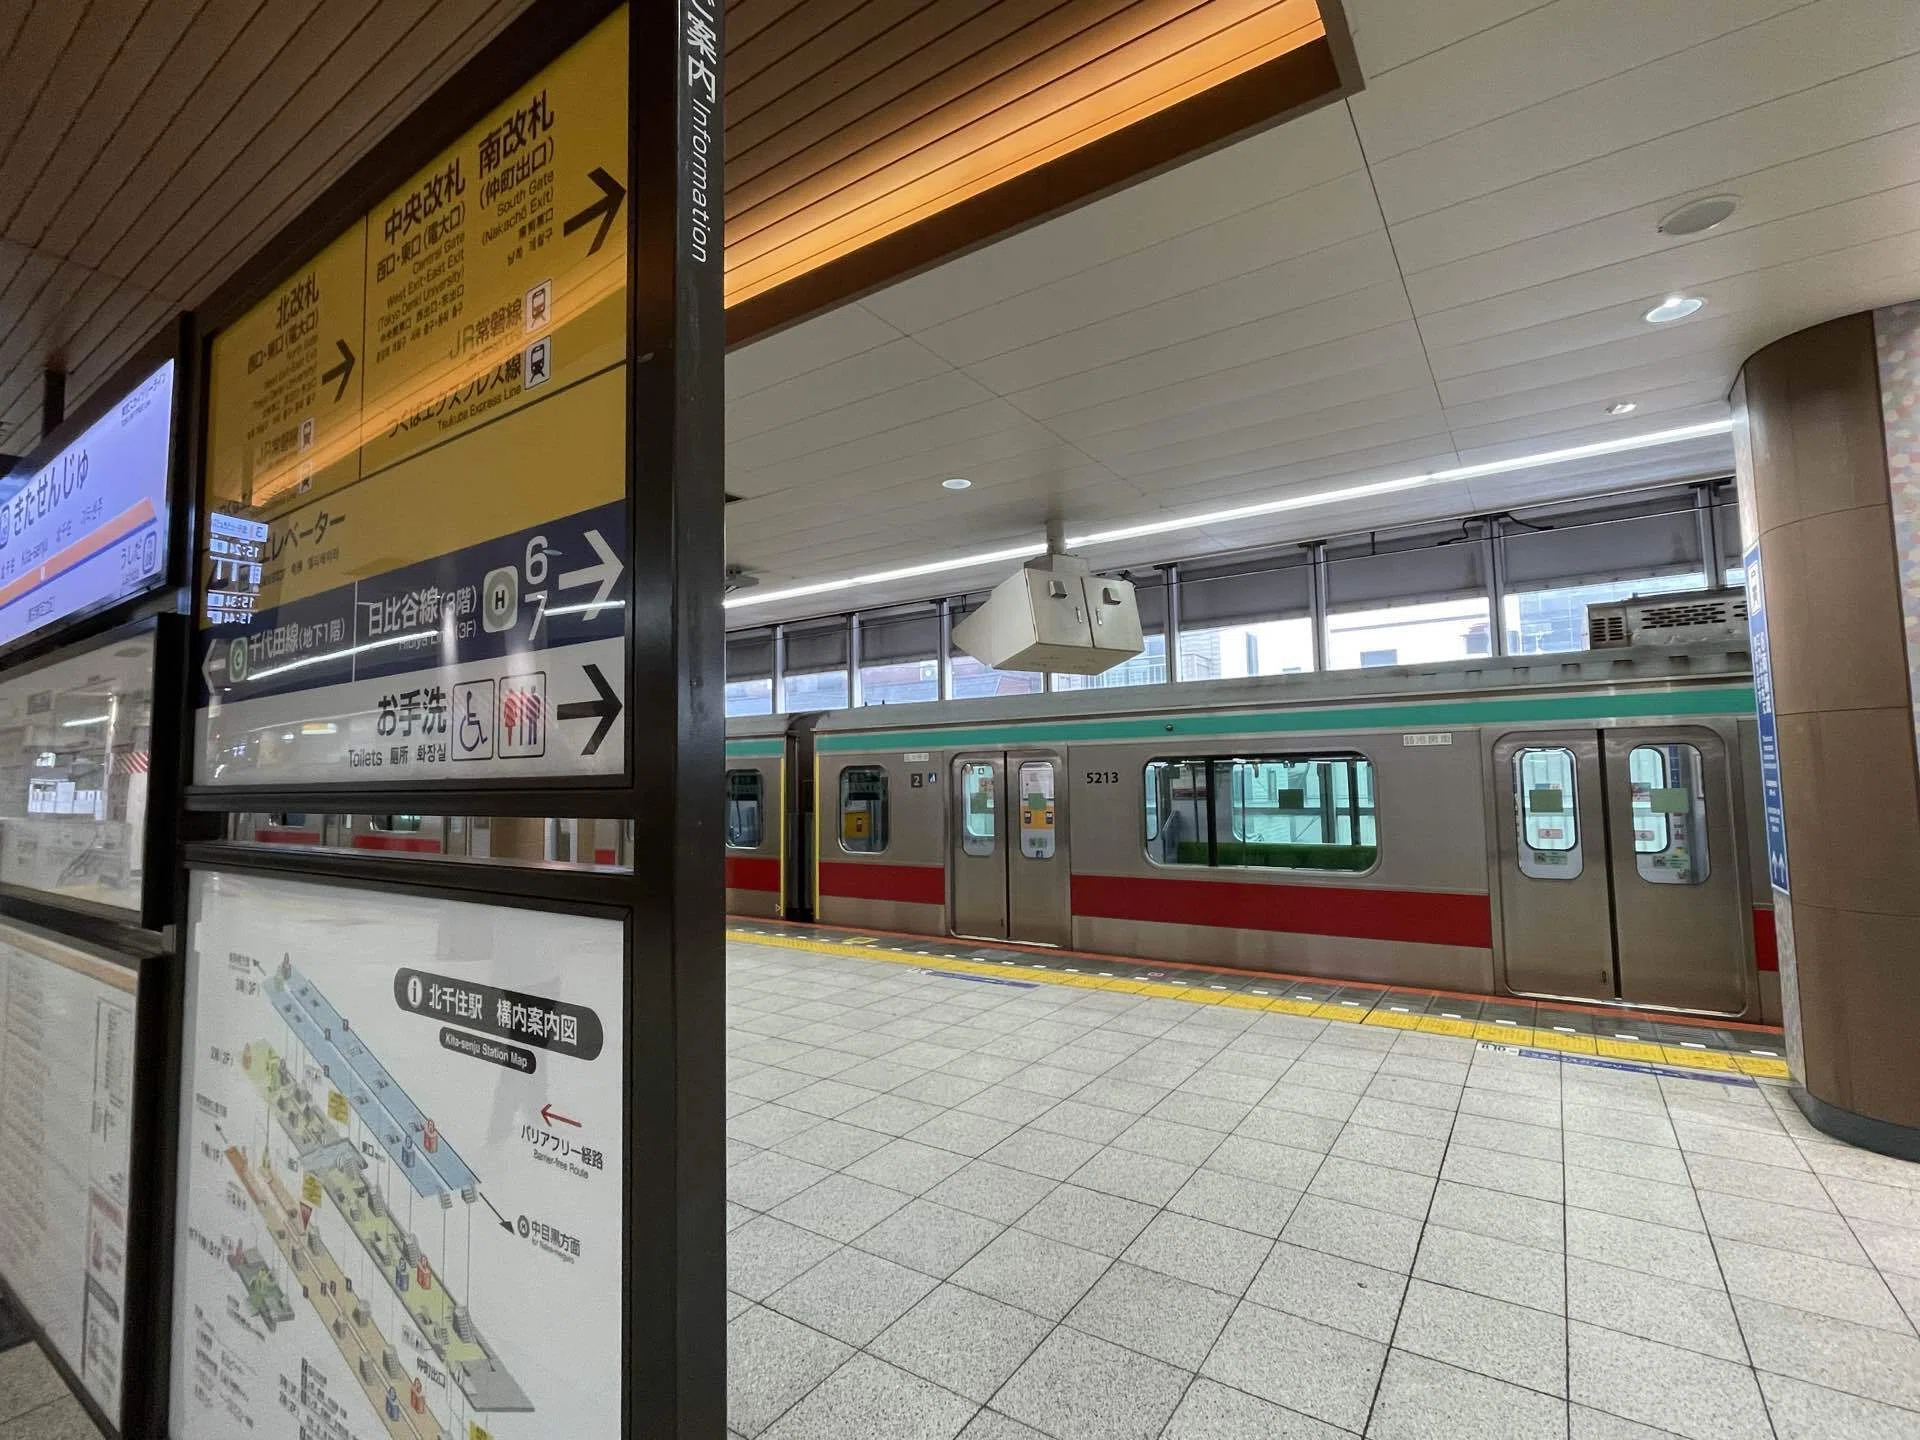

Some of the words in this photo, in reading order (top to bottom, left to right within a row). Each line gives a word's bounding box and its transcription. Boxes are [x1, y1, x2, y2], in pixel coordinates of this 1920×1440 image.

[478, 87, 555, 180] 南改札
[479, 136, 555, 210] (仲町出口)
[497, 189, 527, 217] South
[528, 170, 554, 196] Gate
[692, 98, 712, 264] Information
[385, 157, 465, 246] 中央改札
[276, 271, 320, 330] 北改札
[13, 448, 89, 537] きたせんじゅ
[525, 535, 549, 585] 6
[524, 590, 548, 641] 7
[377, 685, 448, 737] お手洗
[349, 748, 383, 768] Toilets
[913, 775, 921, 787] 2
[1085, 771, 1119, 785] 5213
[428, 983, 483, 1021] 北千住駅
[496, 998, 578, 1047] 構内案内図
[445, 1030, 481, 1054] Kita-senju
[482, 1043, 509, 1063] Station
[510, 1052, 529, 1069] Map
[521, 1124, 603, 1171] バリアフリー経路
[531, 1220, 581, 1257] 中目黒方面
